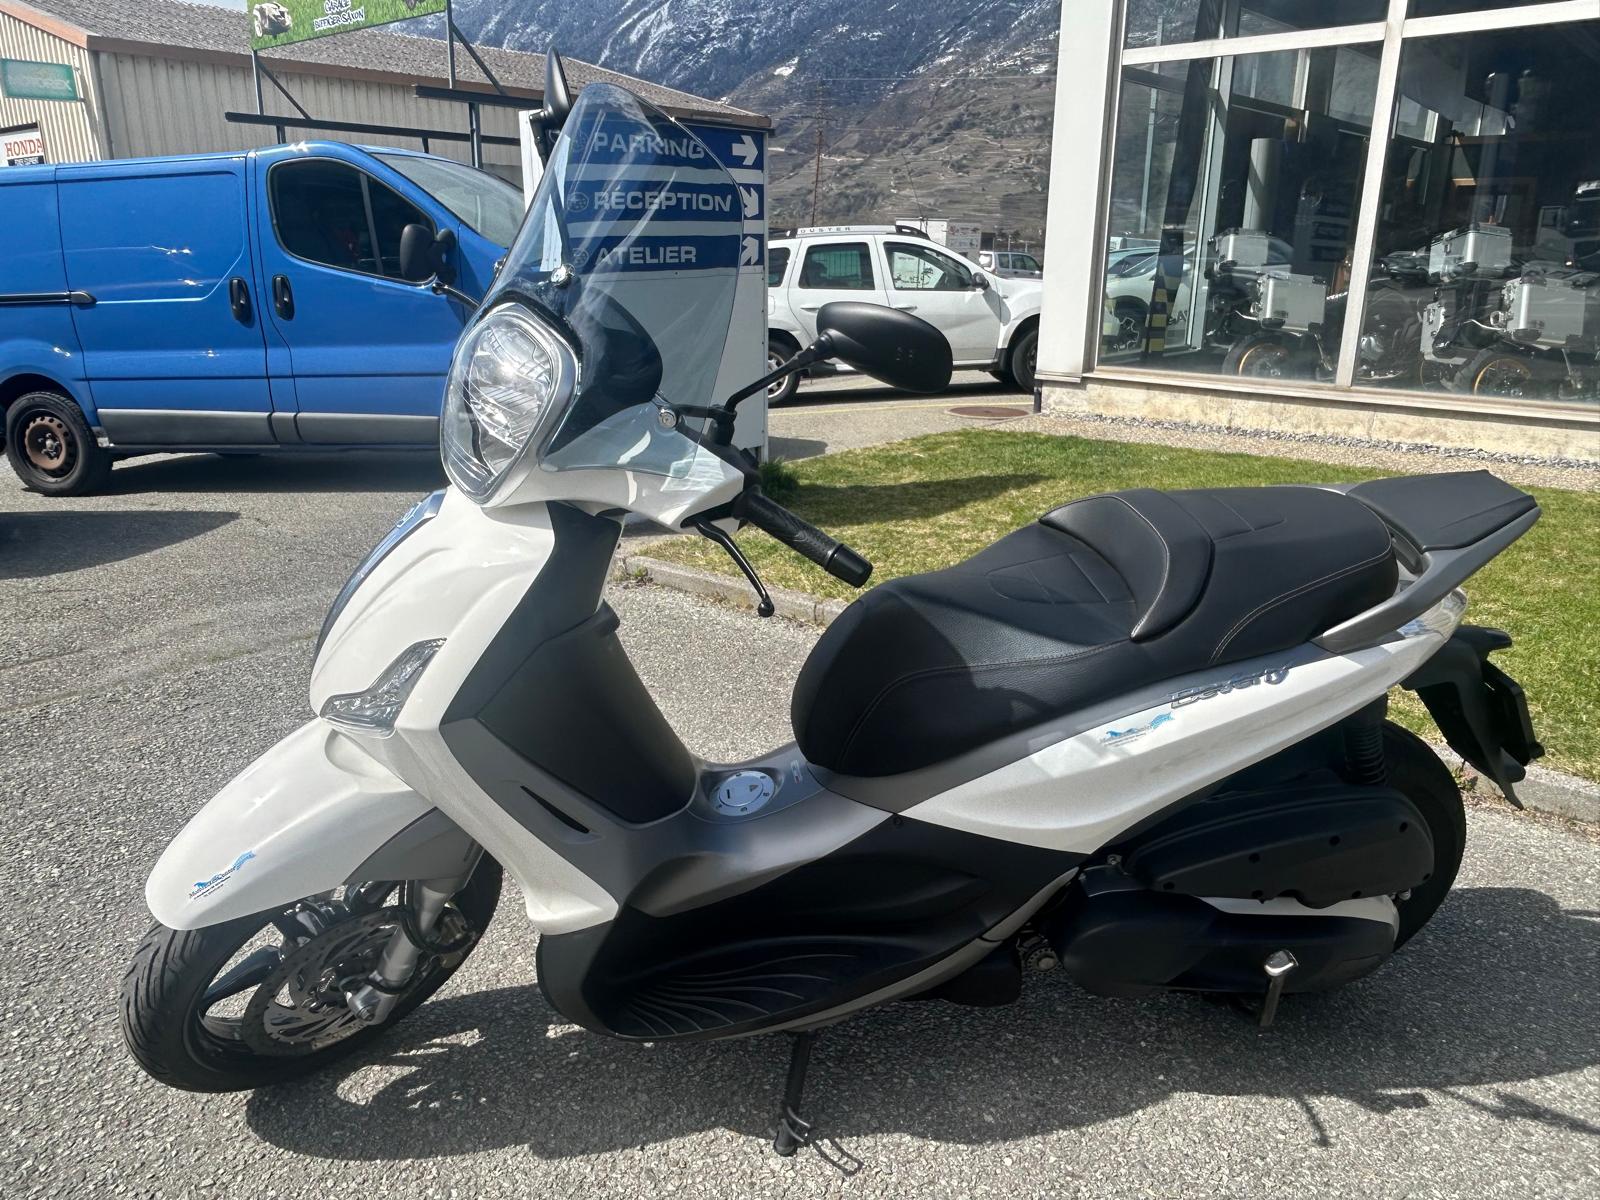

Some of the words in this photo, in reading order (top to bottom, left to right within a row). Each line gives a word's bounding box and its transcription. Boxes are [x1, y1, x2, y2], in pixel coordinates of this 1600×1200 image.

[5, 138, 44, 157] HONDA
[593, 132, 705, 159] PARKING
[800, 226, 851, 234] DUSTER
[594, 245, 697, 265] ATELIER
